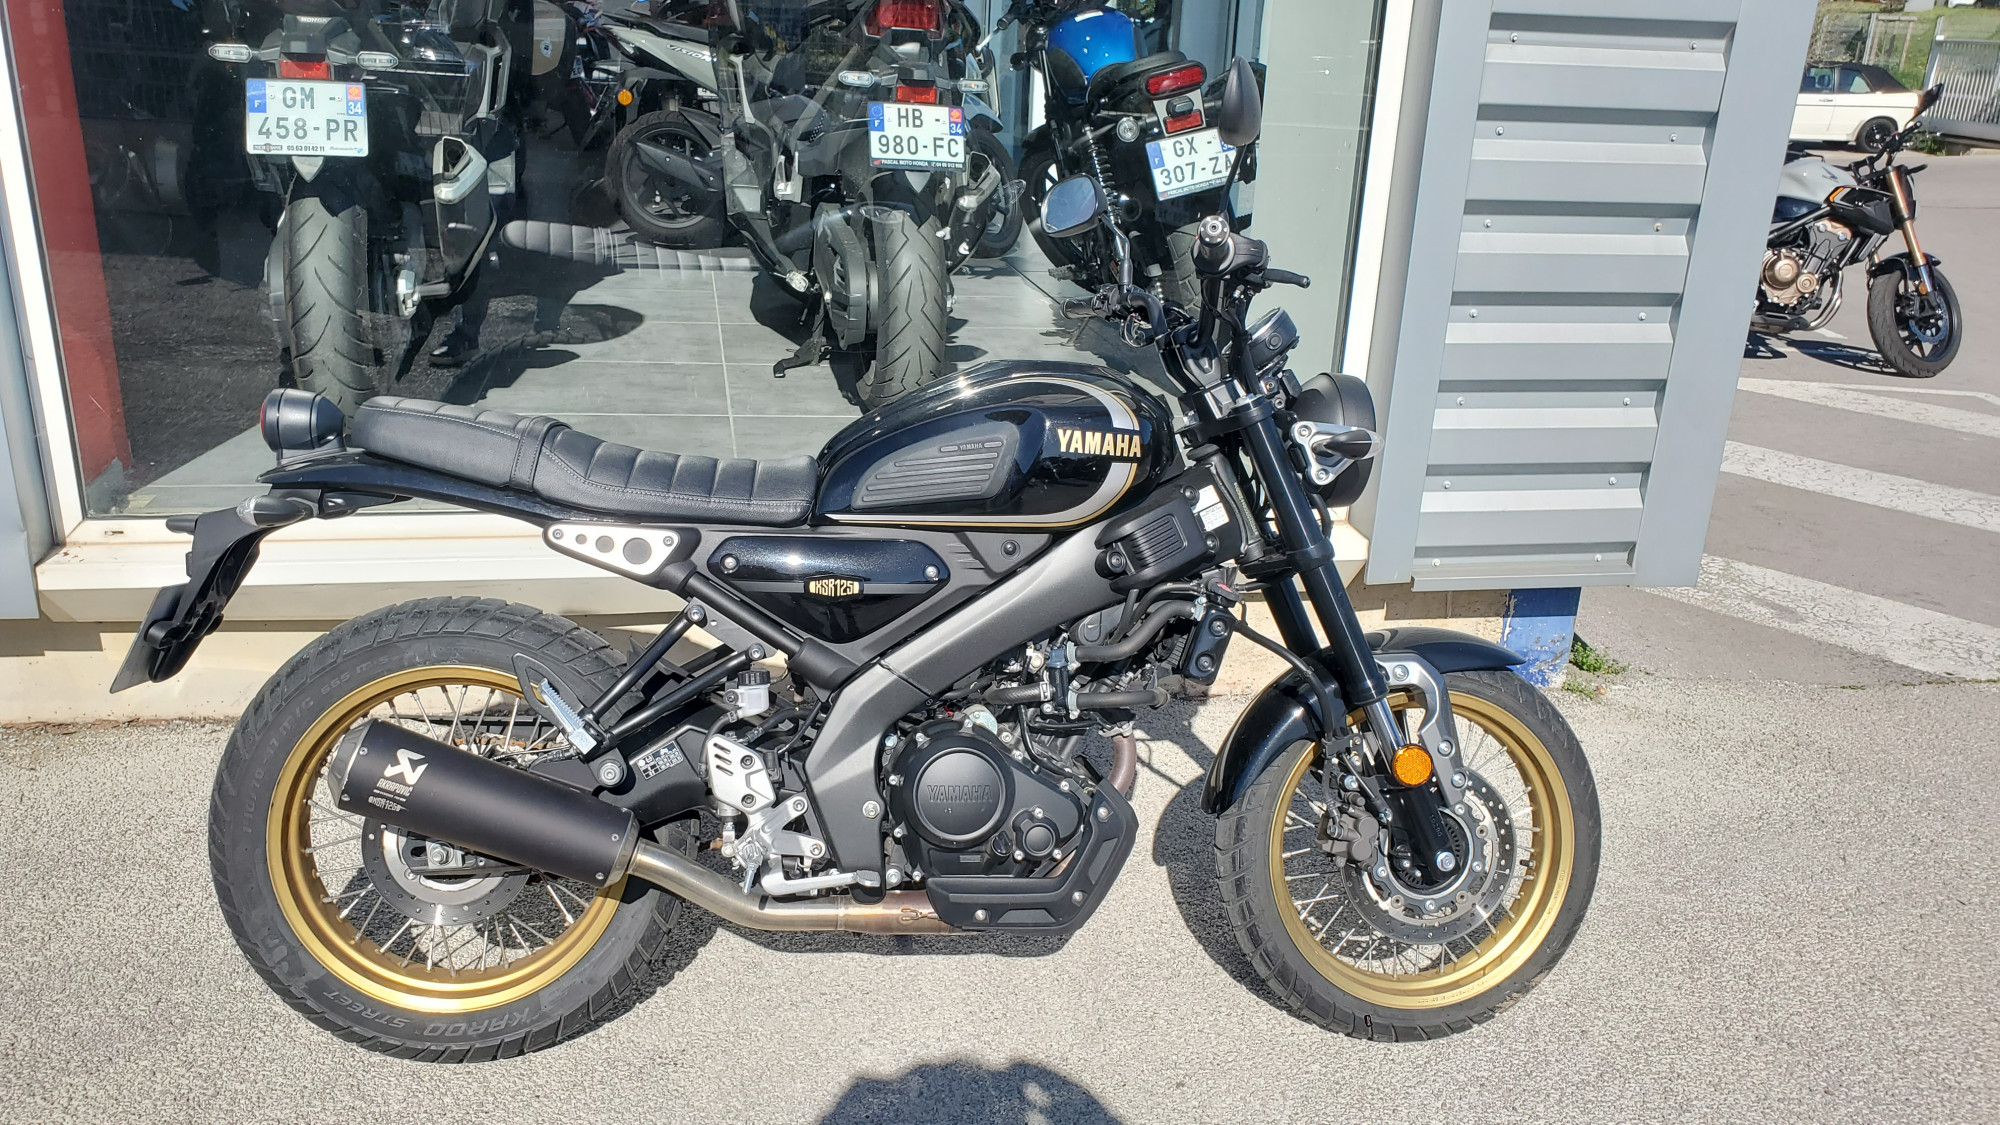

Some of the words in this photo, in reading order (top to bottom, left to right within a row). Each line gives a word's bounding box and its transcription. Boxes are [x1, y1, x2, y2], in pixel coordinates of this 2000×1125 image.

[254, 100, 261, 109] F
[282, 87, 315, 110] GM
[348, 101, 363, 115] 34
[874, 120, 880, 128] F
[897, 108, 923, 128] HB
[950, 123, 962, 134] 34
[1172, 137, 1198, 158] GX
[959, 442, 983, 451] YAMAHA
[1057, 428, 1141, 457] YAMAHA
[815, 579, 853, 597] XSR125
[927, 785, 993, 803] YAMAHA
[322, 990, 413, 1028] STREET
[423, 1006, 531, 1037] KAROO
